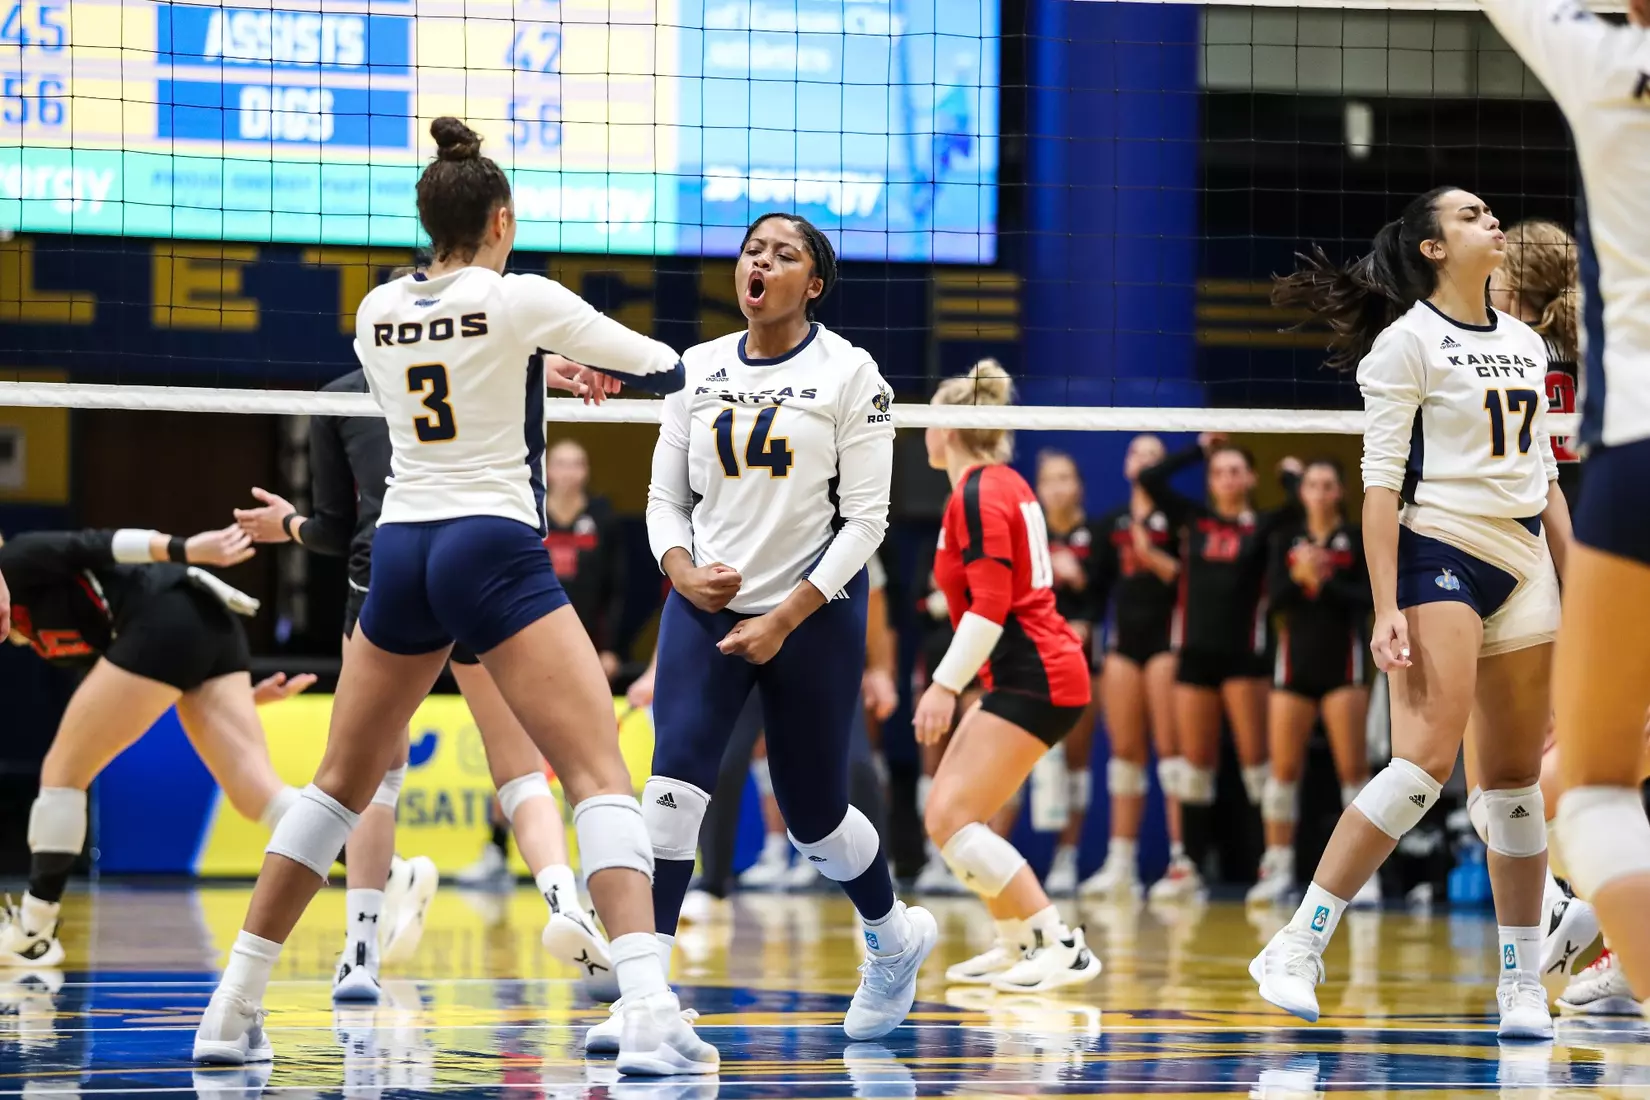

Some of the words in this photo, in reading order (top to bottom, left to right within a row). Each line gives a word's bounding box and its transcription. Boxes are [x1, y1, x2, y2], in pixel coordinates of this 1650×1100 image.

[0, 3, 64, 52] 45
[203, 9, 365, 68] ASSISTS
[505, 29, 563, 79] 42
[4, 75, 64, 125] 56
[239, 85, 334, 142] DIGS
[506, 99, 563, 147] 56
[0, 163, 115, 215] ergy
[373, 312, 488, 347] ROOS
[1448, 354, 1537, 367] KANSAS
[1476, 366, 1525, 378] CITY
[406, 362, 458, 444] 3
[1483, 387, 1539, 458] 17
[711, 404, 794, 479] 14
